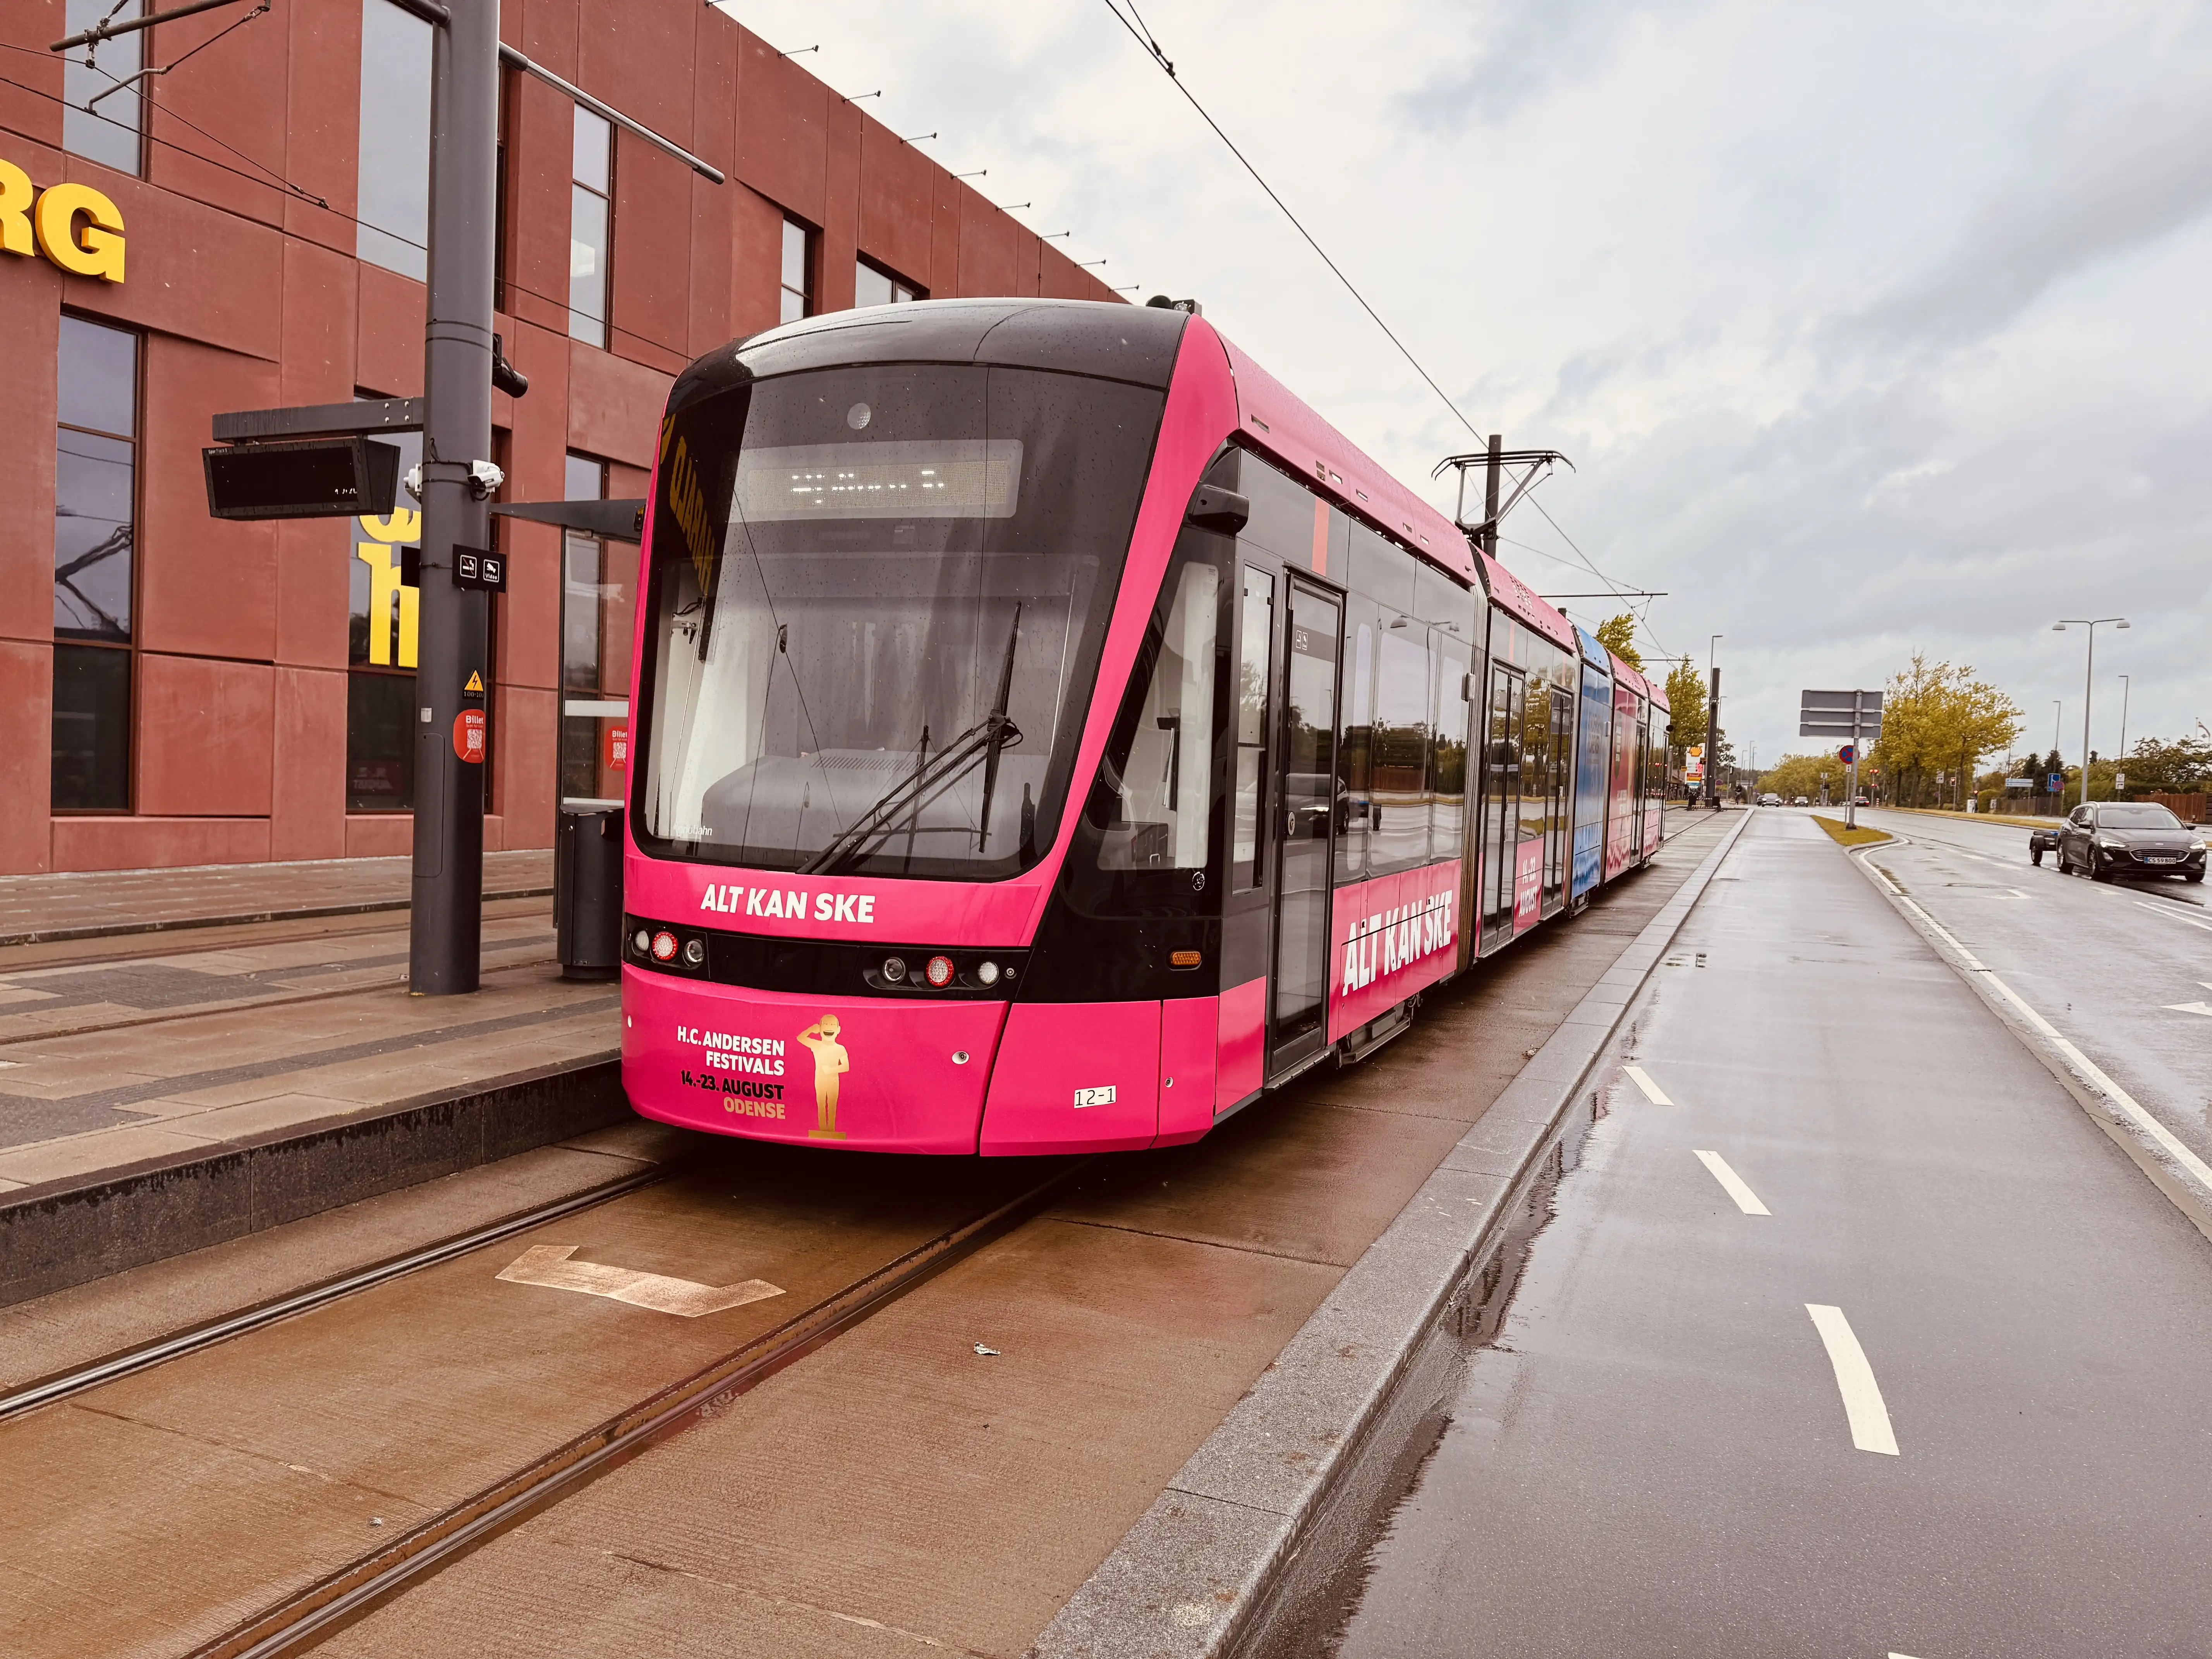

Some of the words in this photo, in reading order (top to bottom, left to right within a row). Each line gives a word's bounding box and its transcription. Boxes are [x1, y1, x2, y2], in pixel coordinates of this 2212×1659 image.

[466, 715, 484, 724] Billet
[700, 883, 744, 914] ALT
[746, 888, 808, 919] KAN
[814, 892, 876, 923] SKE
[1518, 885, 1538, 918] AUGUST
[1342, 913, 1382, 997] ALT
[1383, 899, 1423, 976] KAN
[1424, 890, 1453, 956] SKE
[677, 1025, 702, 1046] H.C.
[702, 1030, 785, 1056] ANDERSEN
[706, 1050, 785, 1076] FESTIVALS
[680, 1070, 720, 1092] 14.-23.
[721, 1078, 785, 1100] AUGUST
[1075, 1088, 1115, 1106] 12-1
[723, 1096, 786, 1120] ODENSE
